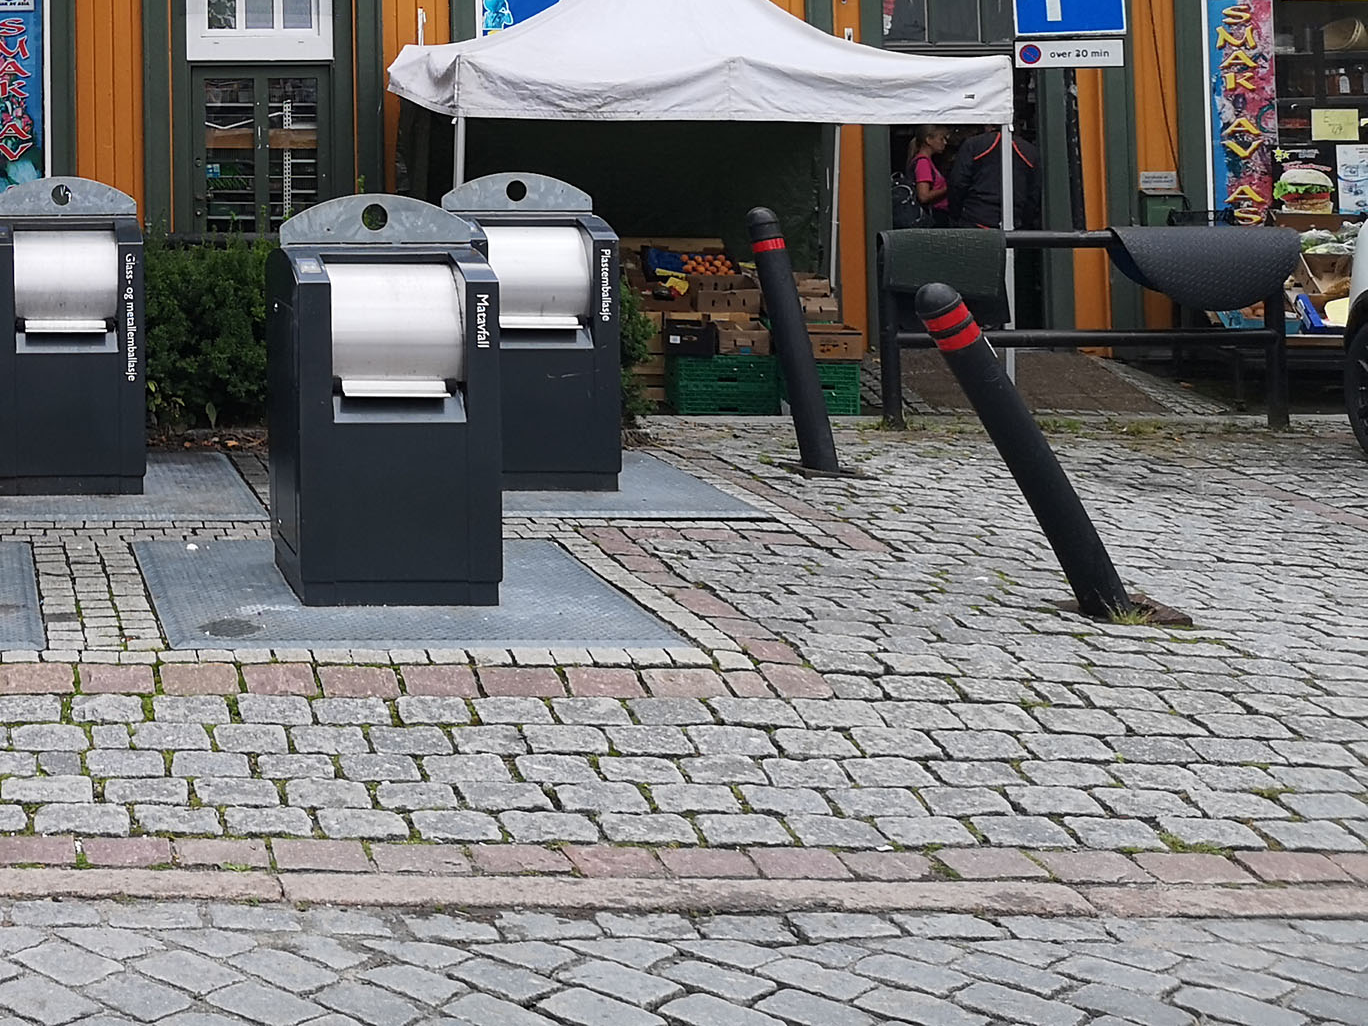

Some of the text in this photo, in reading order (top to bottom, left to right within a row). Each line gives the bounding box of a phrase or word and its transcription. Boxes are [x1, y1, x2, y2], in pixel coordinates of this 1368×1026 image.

[1075, 49, 1089, 58] 20
[1090, 49, 1110, 58] min
[1215, 5, 1268, 225] SMAK AV AS
[123, 253, 138, 382] Glass- og metallemballasje
[476, 294, 490, 348] Matavfall
[600, 248, 612, 322] Plastemballasje
